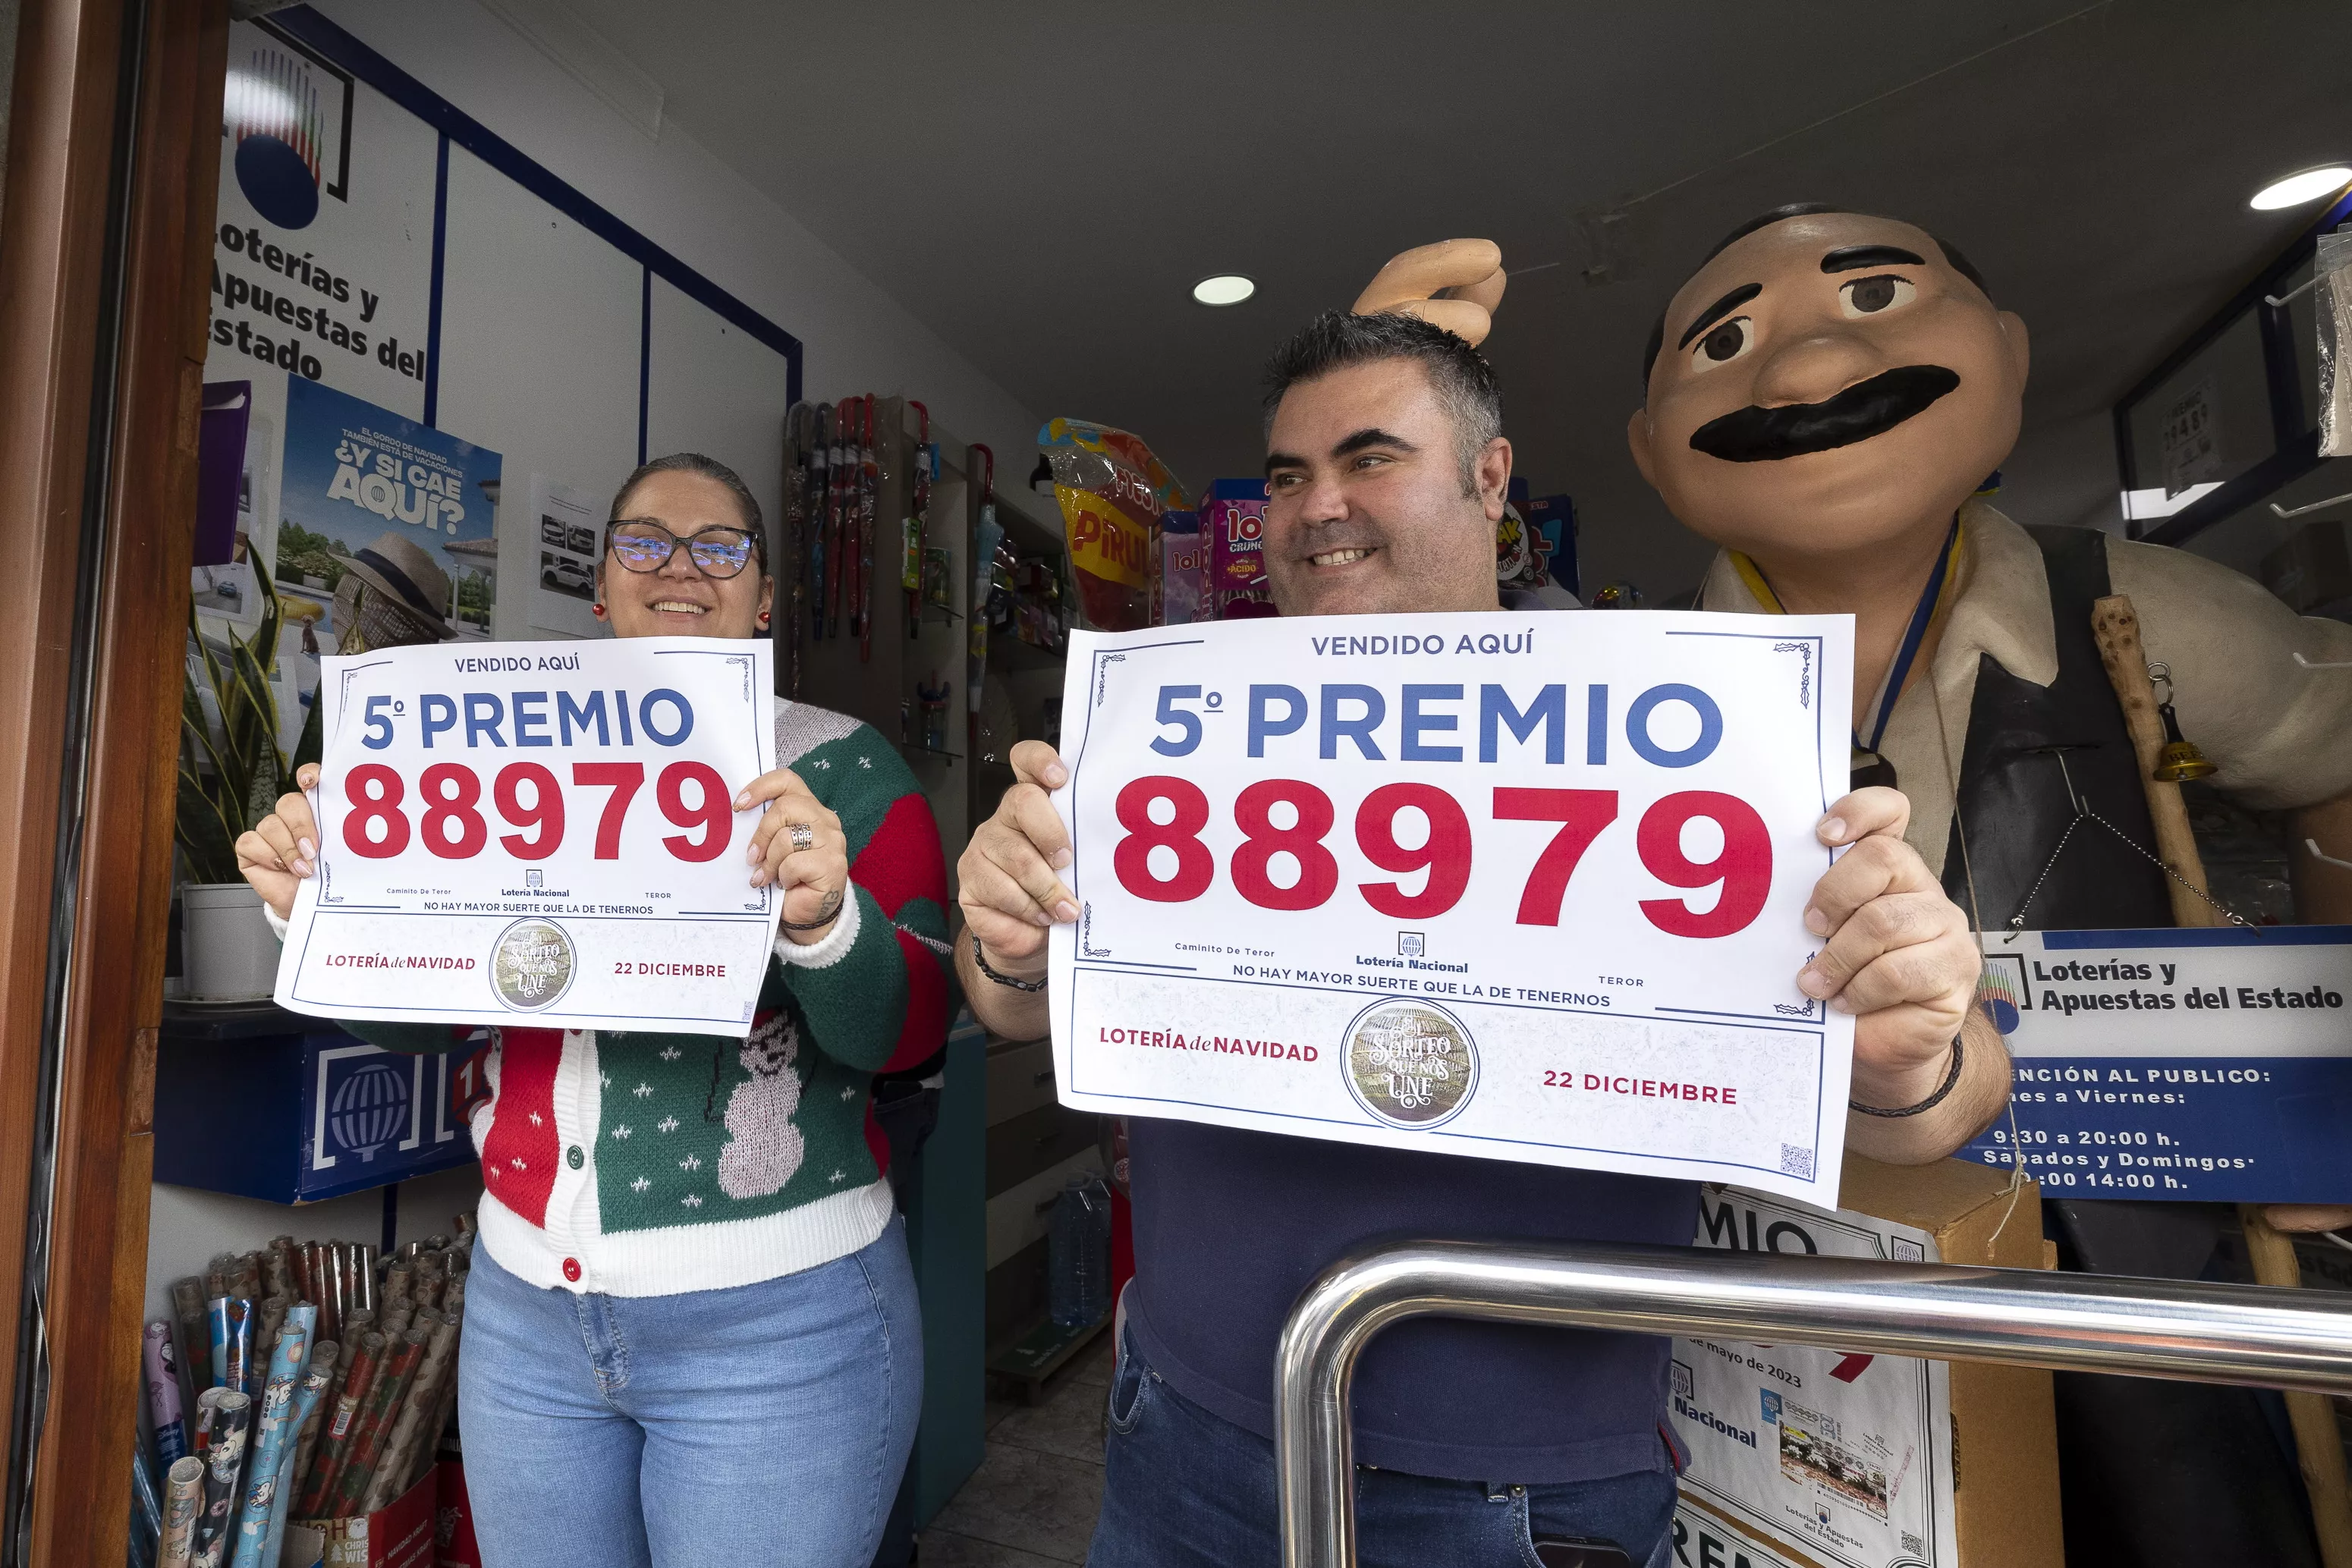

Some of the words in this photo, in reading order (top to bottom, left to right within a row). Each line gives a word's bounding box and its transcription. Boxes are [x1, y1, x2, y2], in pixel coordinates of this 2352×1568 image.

[213, 224, 349, 303] oterías
[360, 288, 379, 323] y
[208, 306, 322, 381] stado
[377, 336, 424, 382] del
[342, 428, 379, 448] TAMBIÉN
[380, 441, 401, 457] ESTÁ
[402, 448, 414, 460] DE
[415, 454, 464, 478] VACACIONES
[362, 426, 373, 438] EL
[373, 431, 401, 449] GORDO
[402, 440, 413, 452] DE
[414, 444, 448, 464] NAVIDAD
[335, 439, 372, 468] ¿Y
[376, 454, 404, 480] SI
[407, 464, 462, 501] CAE
[326, 461, 465, 536] AQUÍ?
[1312, 633, 1445, 657] VENDIDO
[1454, 628, 1534, 655] AQUÍ
[455, 657, 531, 673] VENDIDO
[537, 652, 580, 671] AQUÍ
[361, 695, 405, 750] 5º
[420, 688, 694, 749] PREMIO
[1149, 684, 1224, 758] 5º
[1247, 683, 1724, 768] PREMIO
[342, 761, 734, 863] 88979
[1113, 775, 1774, 939] 88979
[386, 888, 418, 896] Caminito
[501, 888, 531, 897] Lotería
[533, 888, 570, 898] Nacional
[424, 902, 439, 910] NO
[441, 903, 462, 911] HAY
[464, 903, 500, 912] MAYOR
[502, 903, 540, 913] SUERTE
[542, 903, 564, 913] QUE
[567, 905, 580, 913] LA
[582, 905, 596, 914] DE
[598, 906, 653, 915] TENERNOS
[326, 953, 391, 969] LOTERÍA
[407, 957, 476, 970] NAVIDAD
[508, 940, 560, 969] SORTEO
[1174, 942, 1222, 955] Caminito
[1226, 946, 1240, 955] De
[1244, 947, 1275, 958] Teror
[1356, 954, 1404, 969] Lotería
[1407, 957, 1469, 973] Nacional
[514, 973, 548, 998] UNE
[615, 963, 633, 976] 22
[639, 963, 726, 979] DICIEMBRE
[1233, 964, 1256, 977] NO
[1259, 966, 1292, 980] HAY
[1296, 969, 1354, 986] MAYOR
[1357, 974, 1418, 991] SUERTE
[1423, 979, 1460, 997] QUE
[1462, 984, 1485, 998] LA
[1489, 986, 1513, 1001] DE
[1516, 988, 1611, 1007] TENERNOS
[1598, 975, 1645, 988] TEROR
[2033, 958, 2152, 982] Loterías
[2159, 963, 2176, 985] y
[2042, 988, 2175, 1017] Apuestas
[2184, 986, 2229, 1010] del
[2238, 985, 2344, 1009] Estado
[1100, 1027, 1187, 1050] LOTERÍA
[1214, 1036, 1319, 1062] NAVIDAD
[1368, 1027, 1452, 1066] SORTEO
[1388, 1061, 1417, 1076] QUE
[2108, 1068, 2140, 1083] AL
[2147, 1068, 2271, 1083] PUBLICO:
[1381, 1072, 1434, 1109] UNE
[1543, 1070, 1574, 1089] 22
[1584, 1073, 1737, 1105] DICIEMBRE
[2055, 1092, 2068, 1103] a
[2075, 1090, 2185, 1104] Viernes:
[1993, 1130, 2048, 1144] 9:30
[2057, 1133, 2070, 1144] a
[2078, 1131, 2148, 1145] 20:00
[2156, 1133, 2180, 1146] h.
[2097, 1155, 2110, 1168] y
[2086, 1173, 2155, 1188] 14:00
[2163, 1174, 2188, 1189] h.
[1707, 1341, 1743, 1363] mayo
[1747, 1357, 1764, 1372] de
[1768, 1365, 1801, 1388] 2023
[1674, 1395, 1756, 1450] Nacional
[1785, 1505, 1818, 1526] Loterías
[1825, 1524, 1864, 1549] Apuestas
[1803, 1522, 1816, 1534] del
[1818, 1529, 1844, 1549] Estado
[388, 1532, 413, 1559] NAVIDAD
